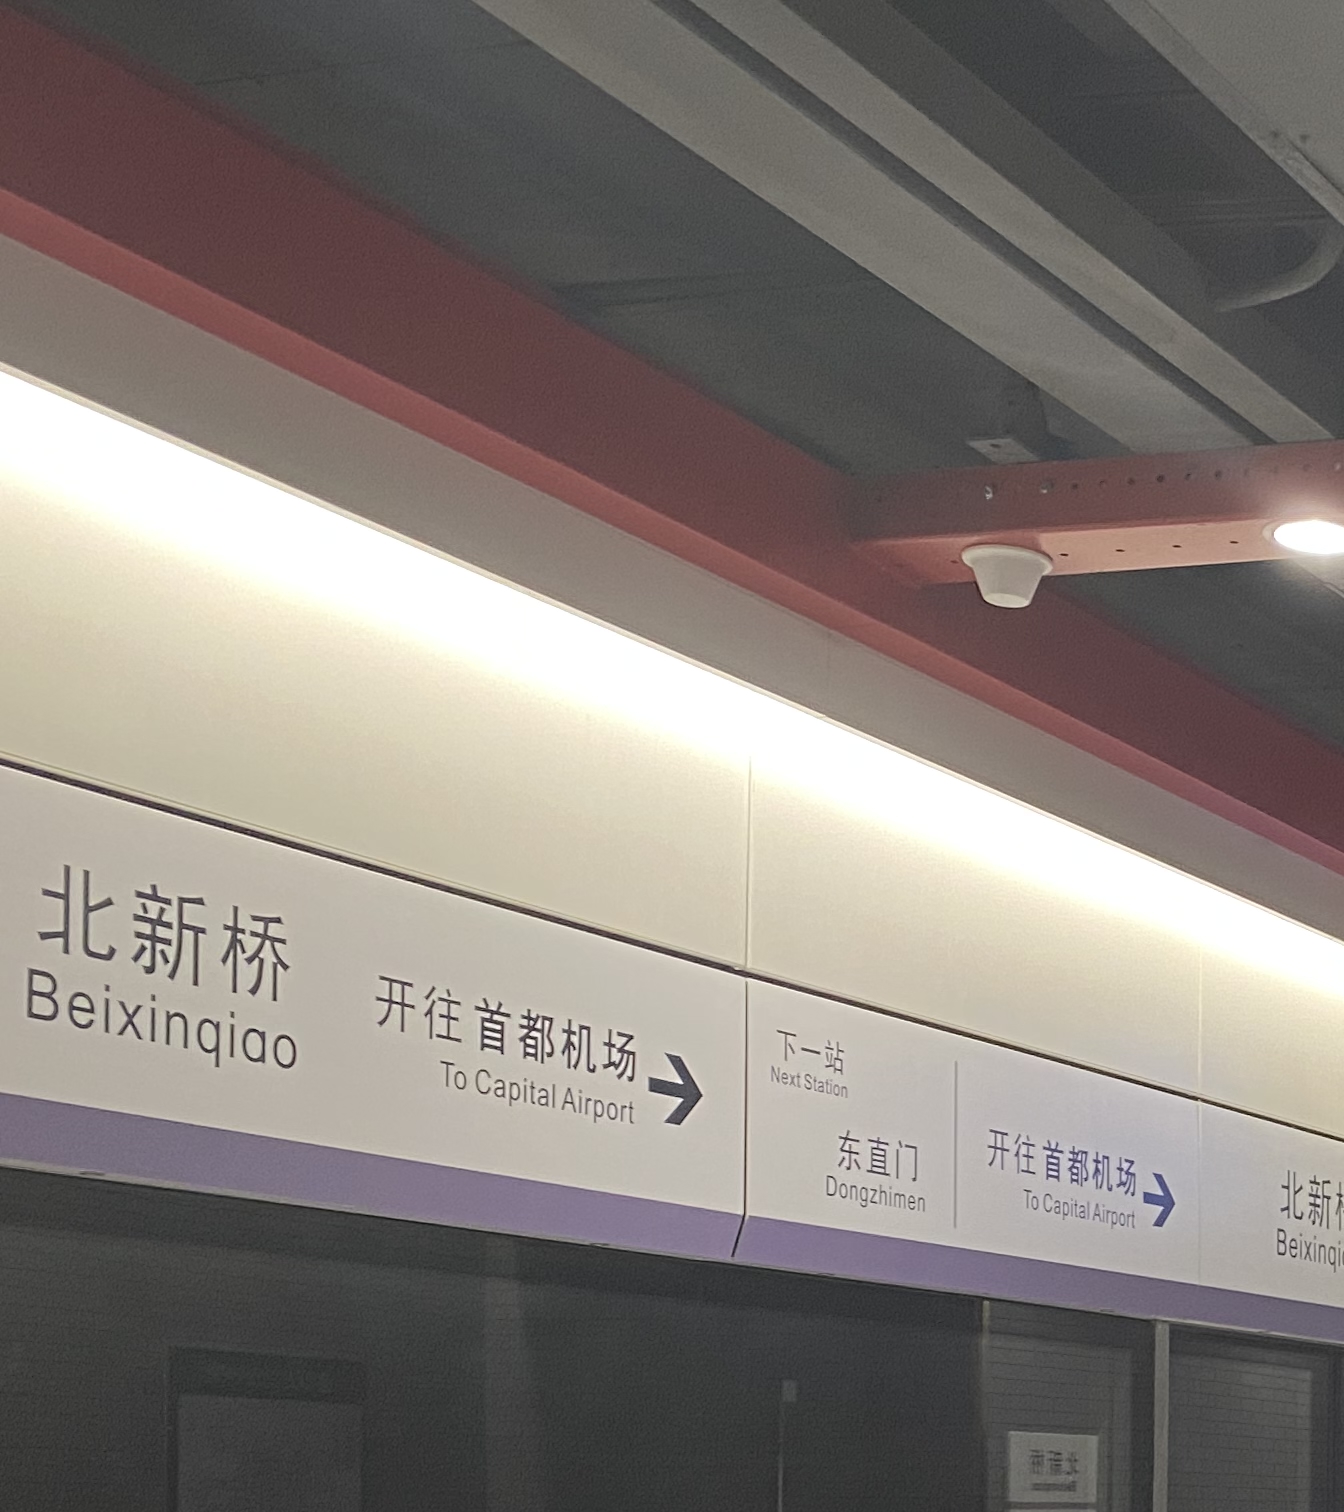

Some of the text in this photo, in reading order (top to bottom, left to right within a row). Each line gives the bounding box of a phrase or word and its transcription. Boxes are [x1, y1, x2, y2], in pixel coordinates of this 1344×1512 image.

[37, 864, 291, 1003] 北新桥
[26, 968, 298, 1070] Beixinqiao
[375, 973, 639, 1084] 开往首都机场
[770, 1065, 849, 1099] Next Station
[776, 1028, 846, 1076] 下一站
[441, 1060, 635, 1126] To Capital Airport
[837, 1129, 919, 1183] 东直门
[987, 1128, 1137, 1198] 开往首都机场
[826, 1175, 926, 1213] Dongzhimen
[1023, 1189, 1136, 1229] To Capital Airport
